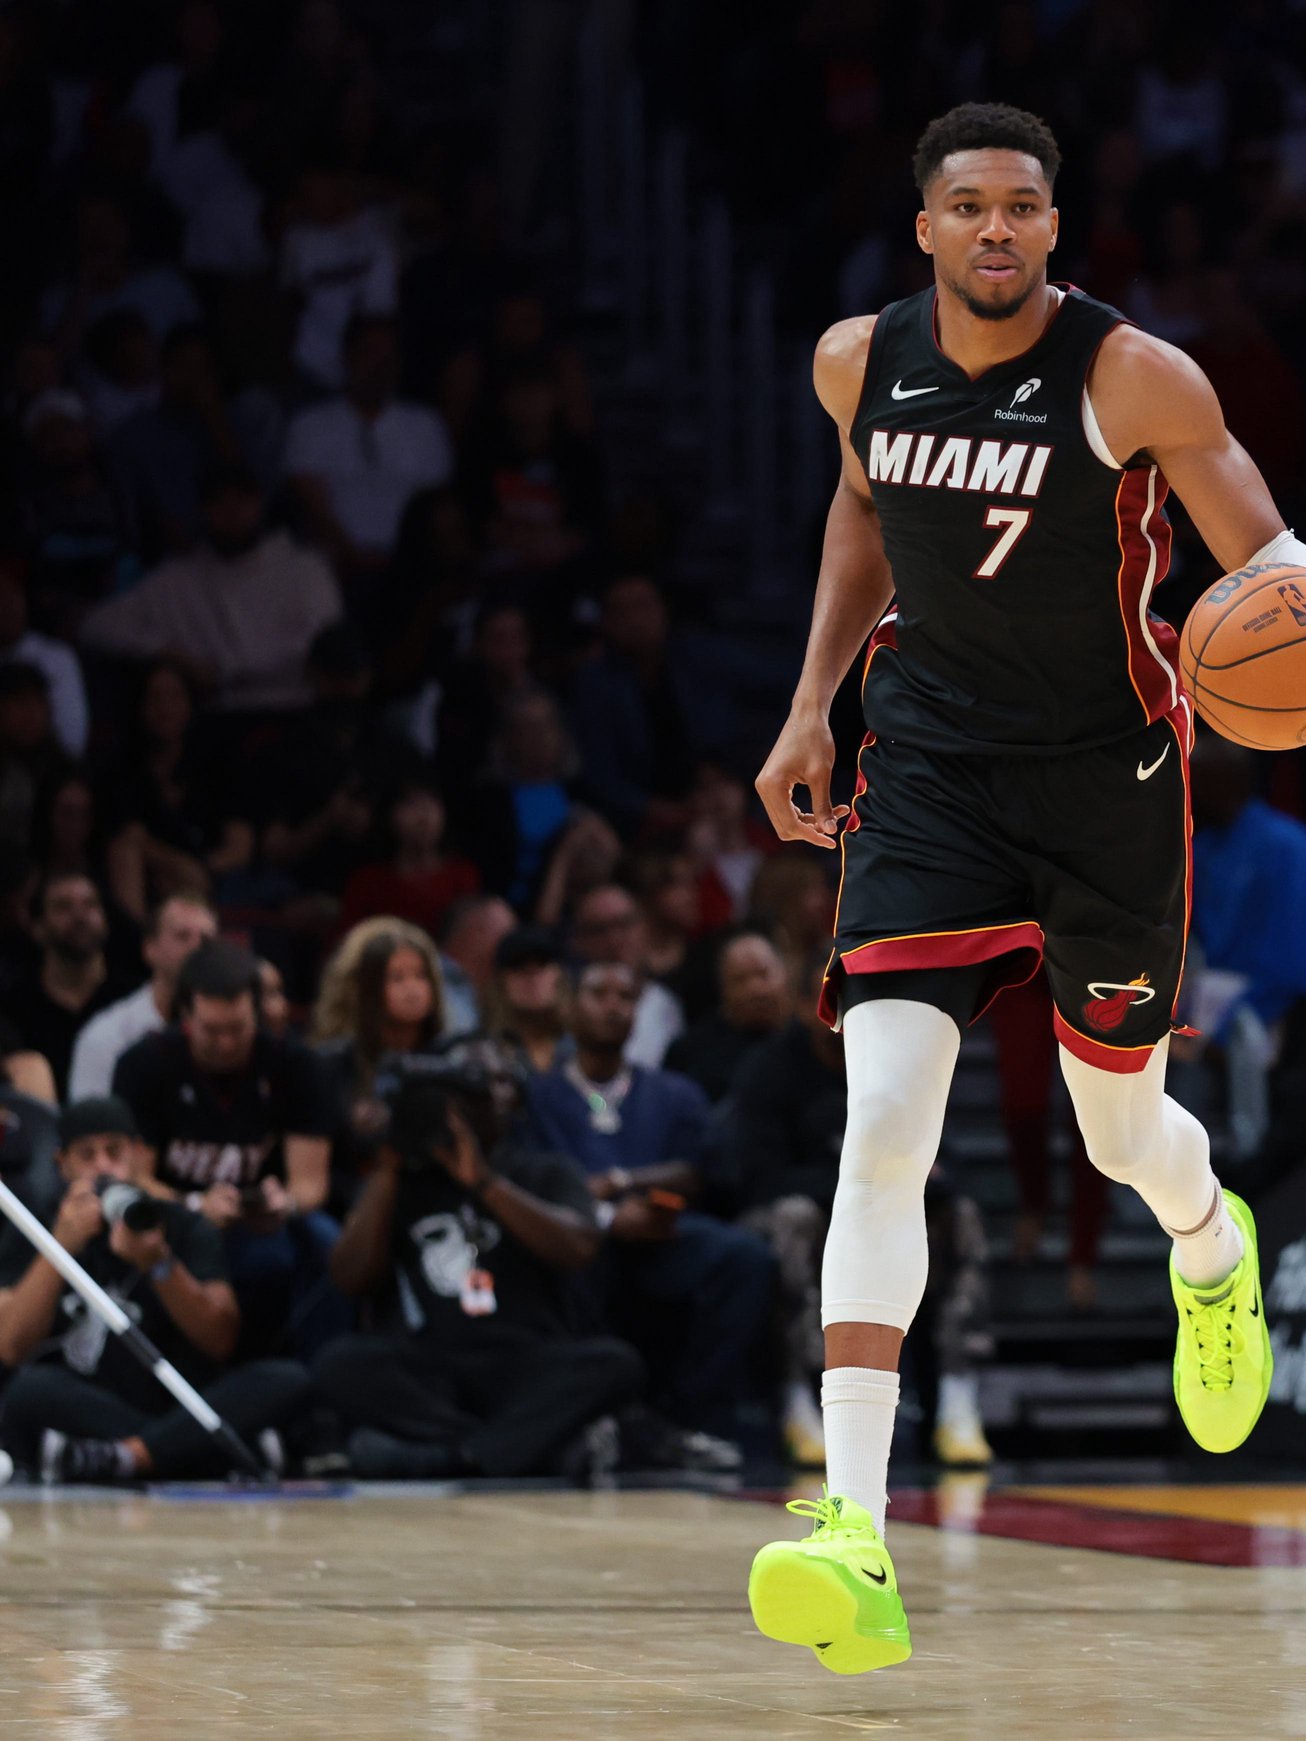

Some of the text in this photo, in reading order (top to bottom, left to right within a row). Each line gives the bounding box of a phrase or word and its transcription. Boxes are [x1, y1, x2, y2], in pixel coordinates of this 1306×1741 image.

[994, 409, 1048, 424] Robinhood
[868, 428, 1054, 497] MIAMI
[973, 504, 1033, 579] 7
